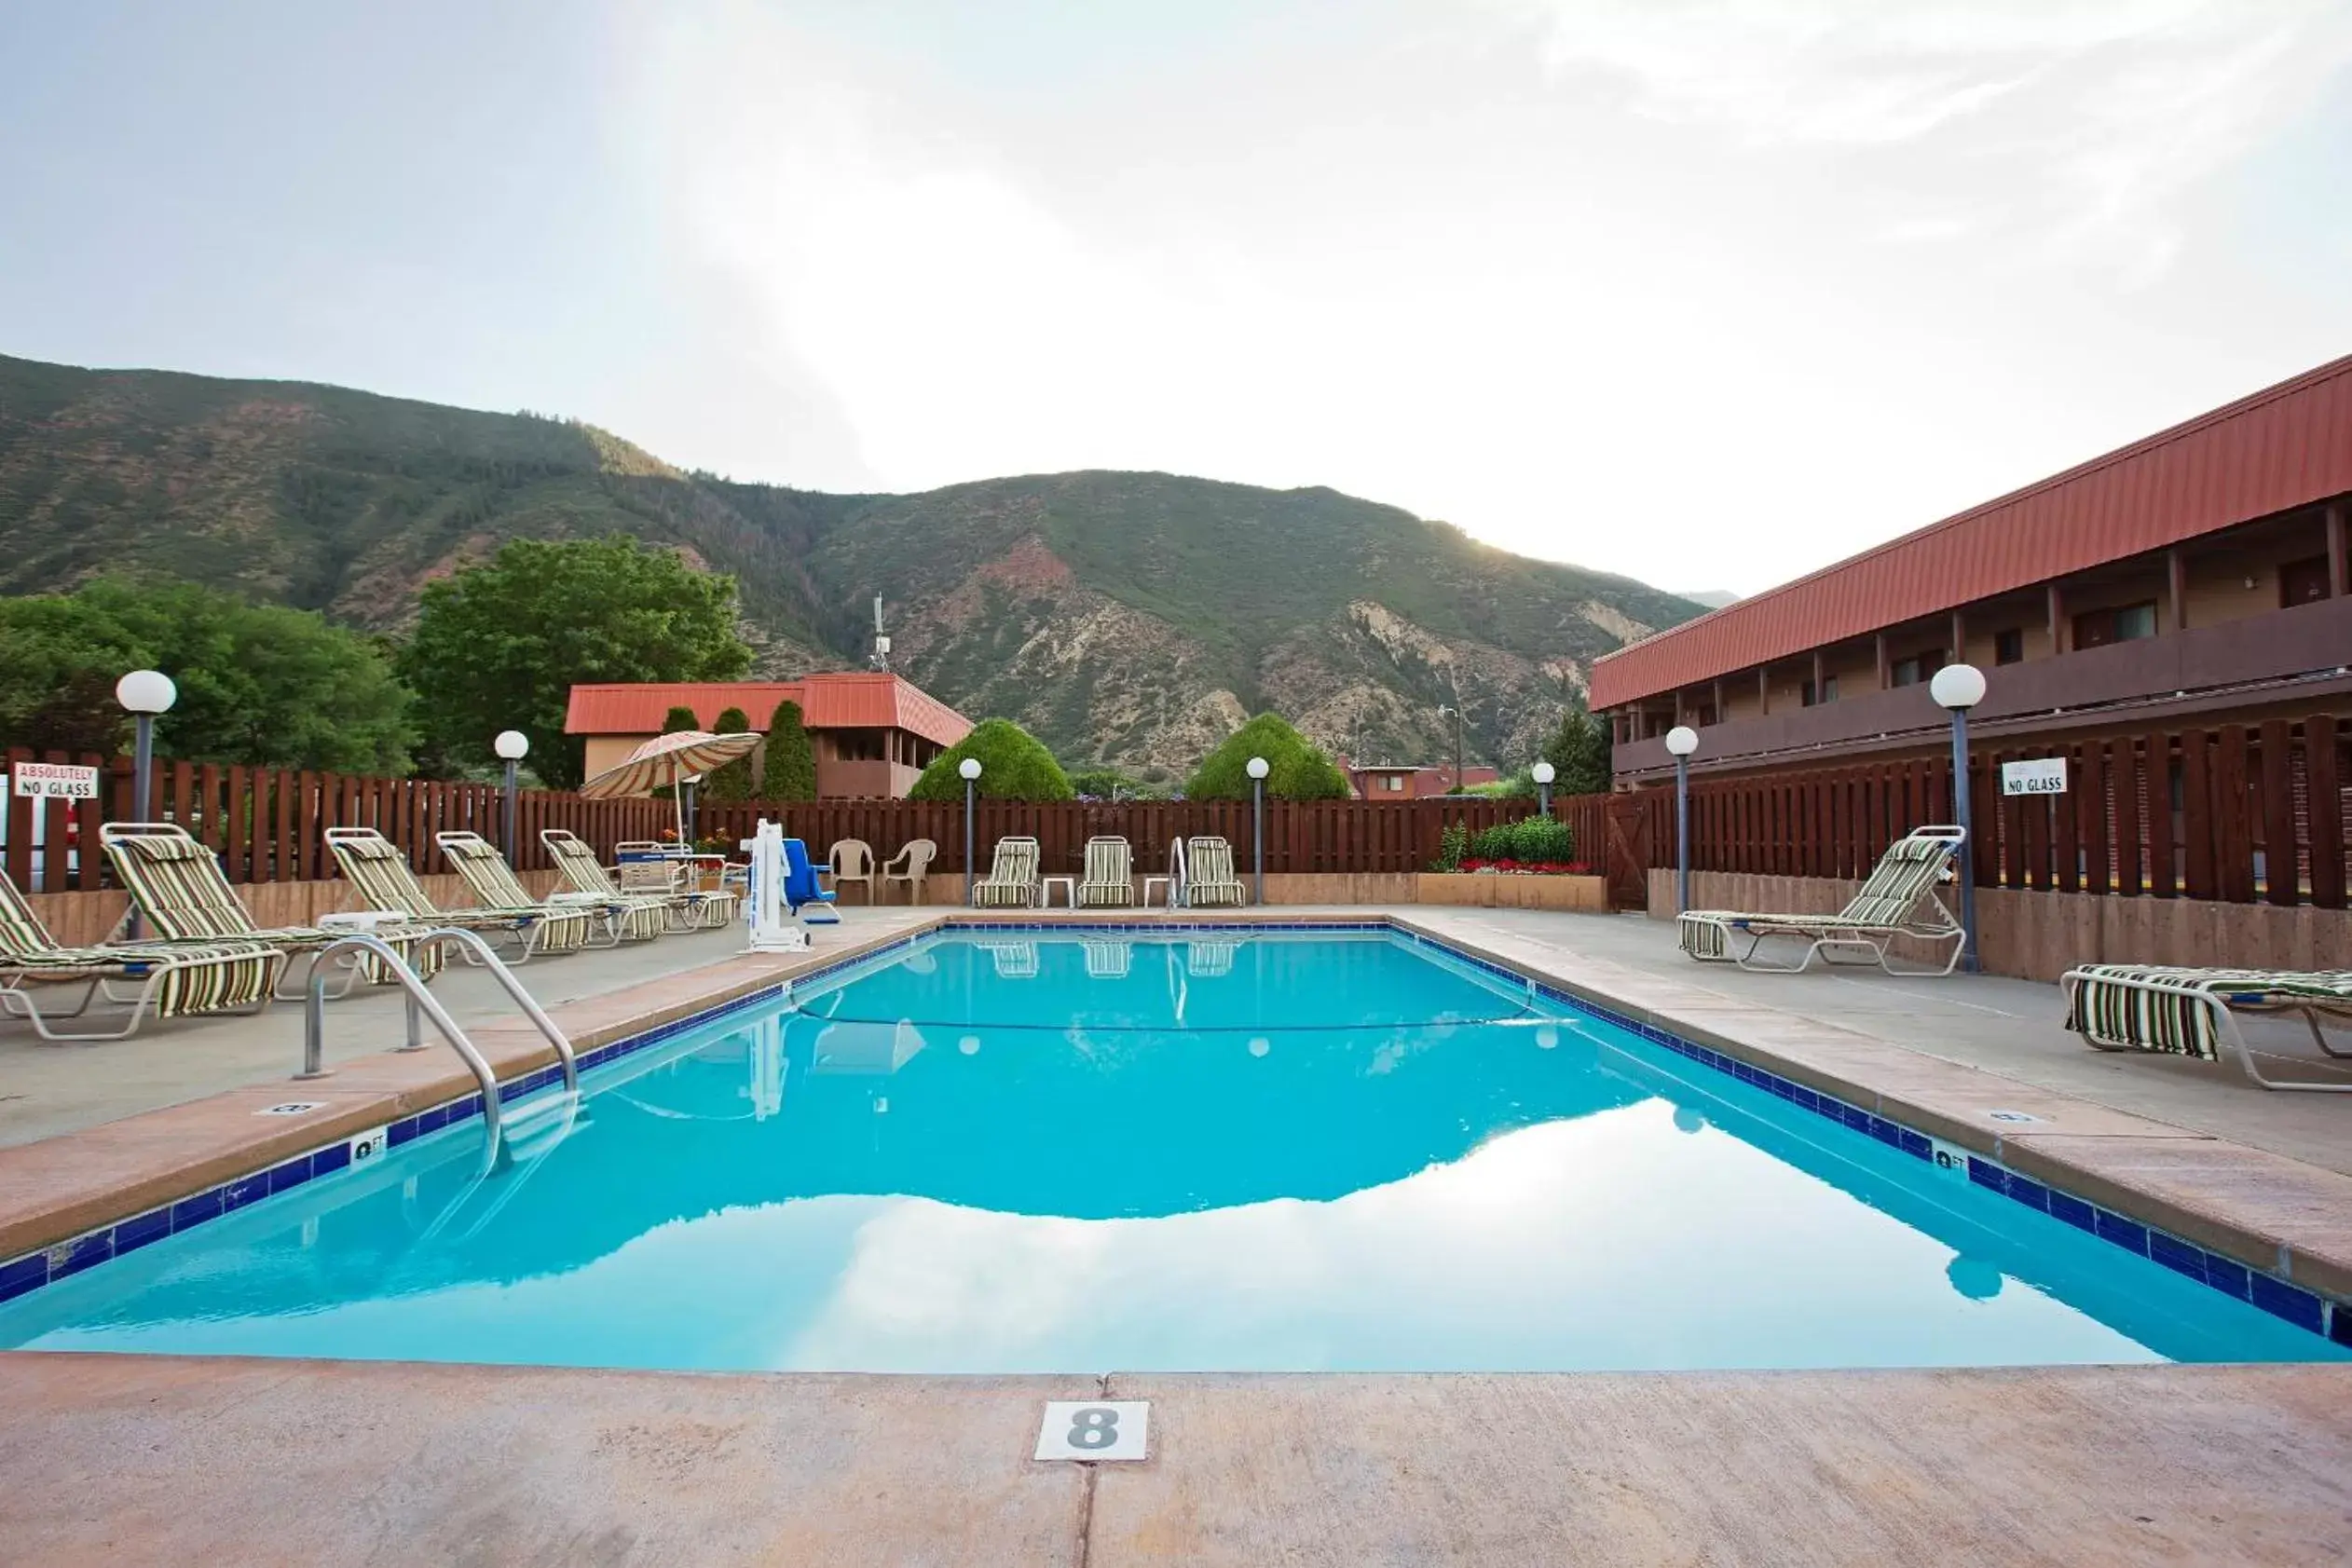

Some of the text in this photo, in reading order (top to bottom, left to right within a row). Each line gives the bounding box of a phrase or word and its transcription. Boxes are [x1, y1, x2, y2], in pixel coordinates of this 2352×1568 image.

[20, 766, 92, 780] ABSOLUTELY
[22, 782, 90, 796] NO GLASS
[2008, 777, 2061, 792] NO GLASS
[1067, 1408, 1119, 1449] 8
